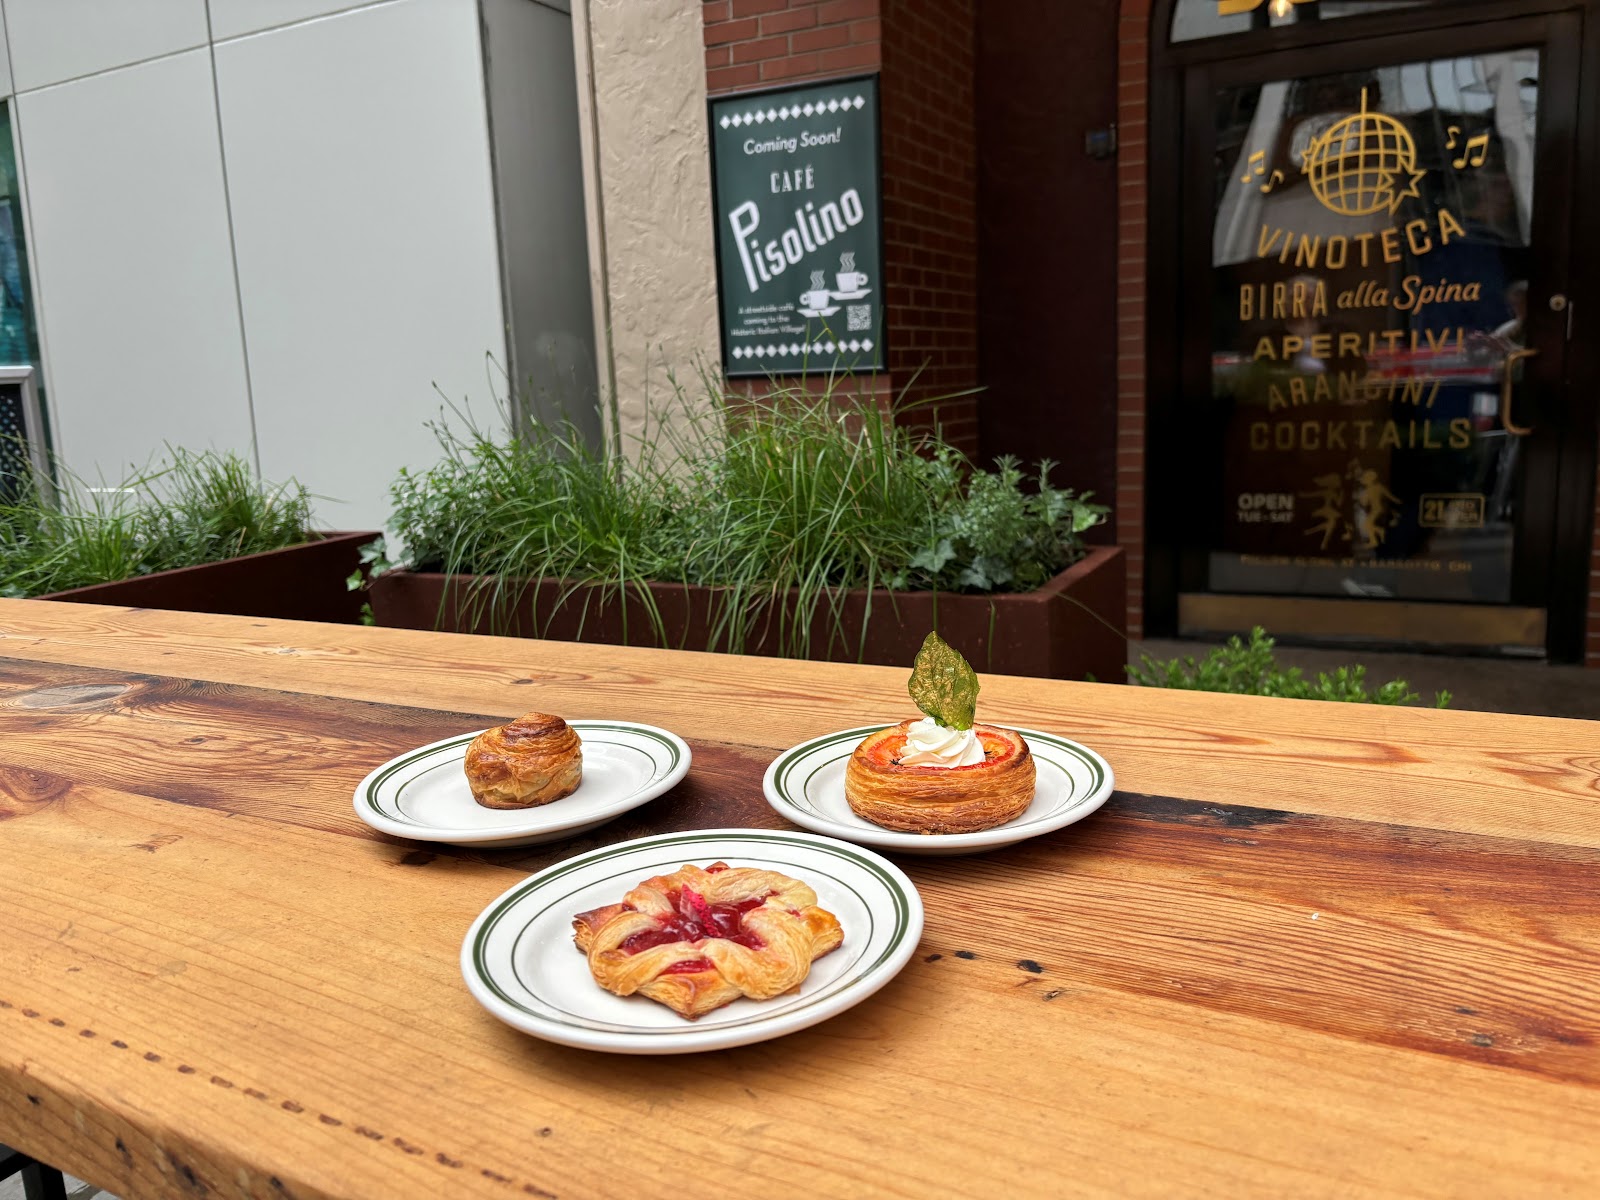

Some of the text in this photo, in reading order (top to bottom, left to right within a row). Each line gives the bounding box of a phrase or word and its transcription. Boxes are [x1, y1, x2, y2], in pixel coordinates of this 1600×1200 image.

[743, 126, 842, 155] Coming Soon!
[770, 163, 815, 194] CAFÉ
[728, 188, 865, 293] Pisolino
[1257, 208, 1467, 270] VINOTECA
[1239, 274, 1481, 321] BIRRA alla Spina
[1252, 326, 1465, 361] APERITIVI
[1268, 369, 1442, 413] ARANCINI
[1248, 416, 1473, 452] COCKTAILS
[1237, 492, 1295, 510] OPEN
[1424, 499, 1445, 521] 21
